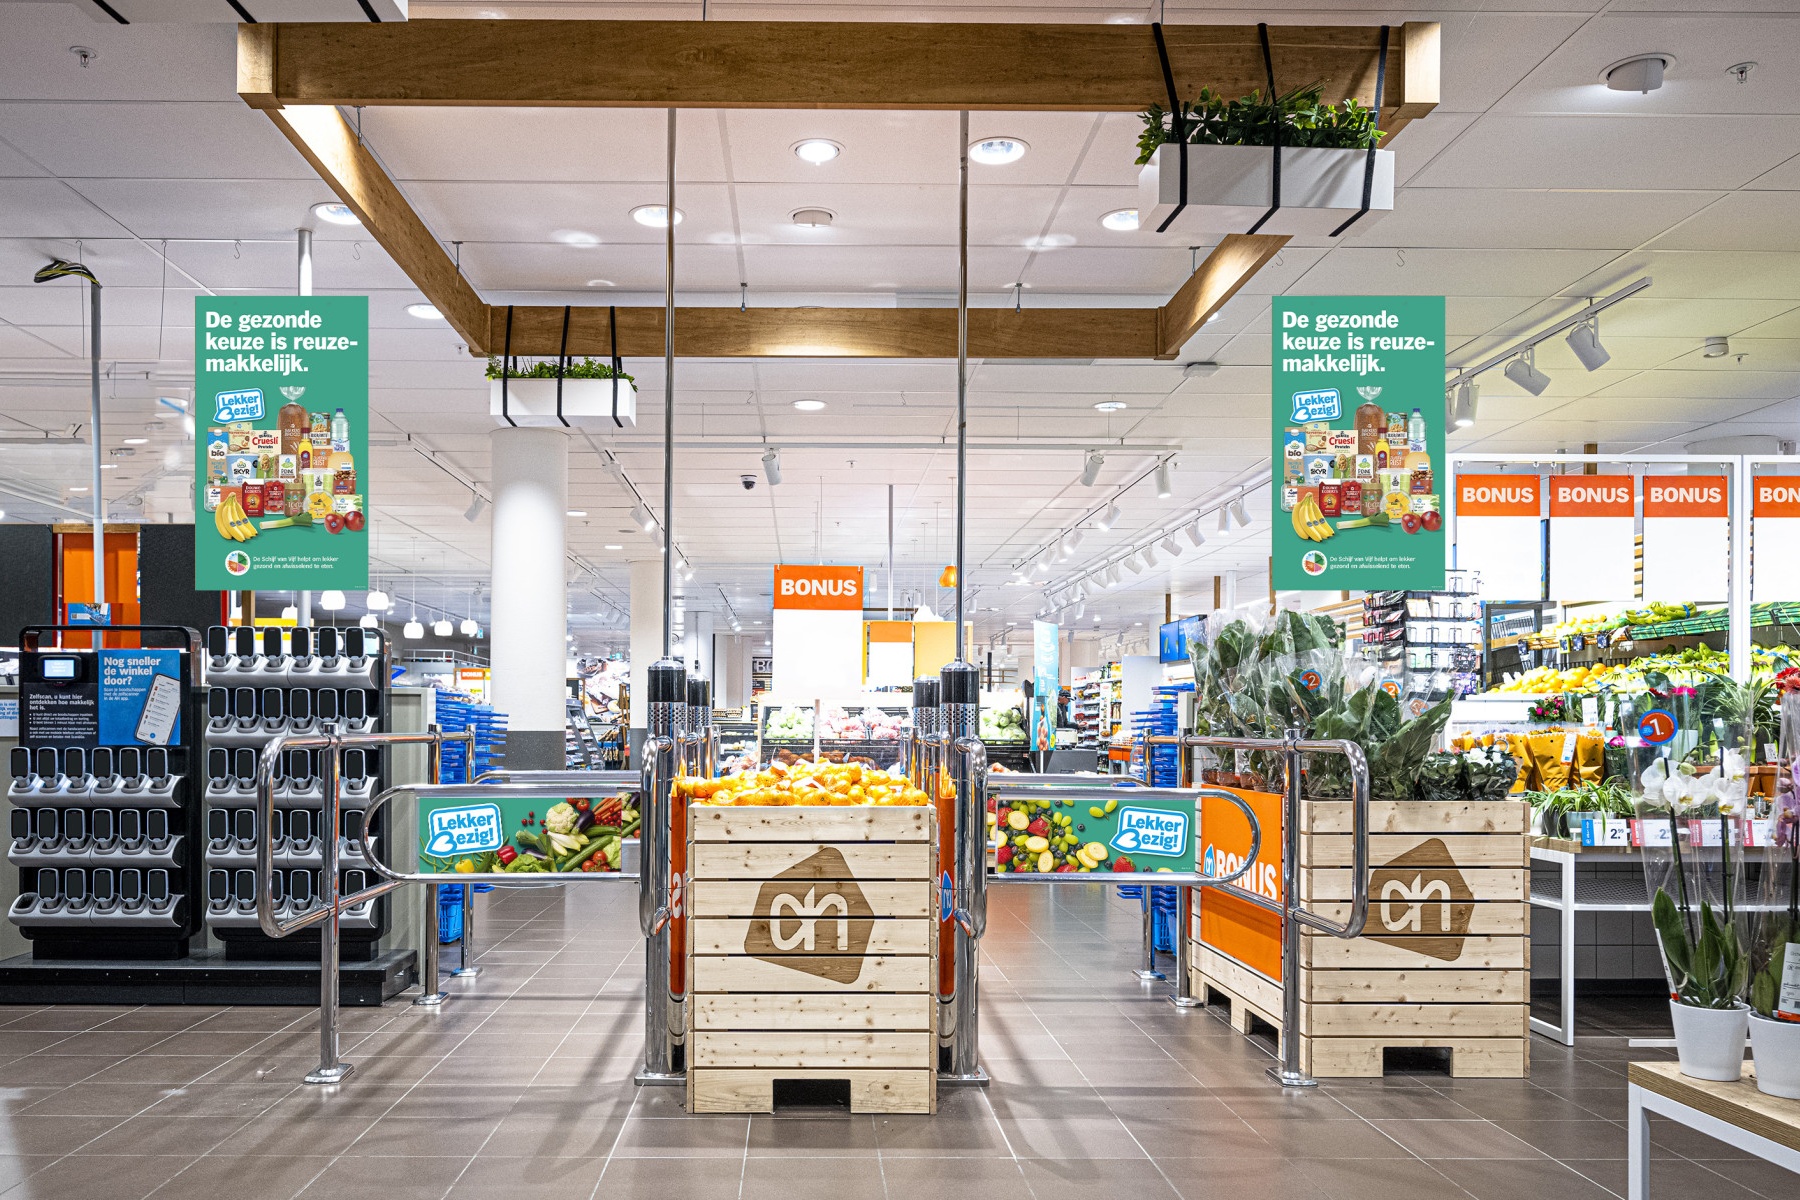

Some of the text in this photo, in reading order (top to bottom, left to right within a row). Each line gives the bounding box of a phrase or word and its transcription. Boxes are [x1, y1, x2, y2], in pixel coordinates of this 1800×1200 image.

[206, 310, 322, 332] De gezonde
[1282, 310, 1399, 332] De gezonde
[206, 332, 358, 350] keuze is reuze-
[1282, 332, 1435, 350] keuze is reuze-
[206, 354, 308, 376] makkelijk.
[1282, 354, 1386, 376] makkelijk.
[221, 392, 259, 408] Lekker
[1298, 392, 1336, 408] Lekker
[252, 436, 278, 446] Cruesli
[1328, 436, 1356, 446] Cruesli
[1462, 487, 1534, 503] BONUS
[1558, 487, 1630, 503] BONUS
[1650, 487, 1722, 503] BONUS
[781, 579, 857, 596] BONUS
[104, 656, 161, 667] Nog sneller
[104, 666, 152, 675] de winkel
[104, 676, 132, 685] door?
[438, 813, 494, 831] Lekker
[1127, 815, 1182, 832] Lekker
